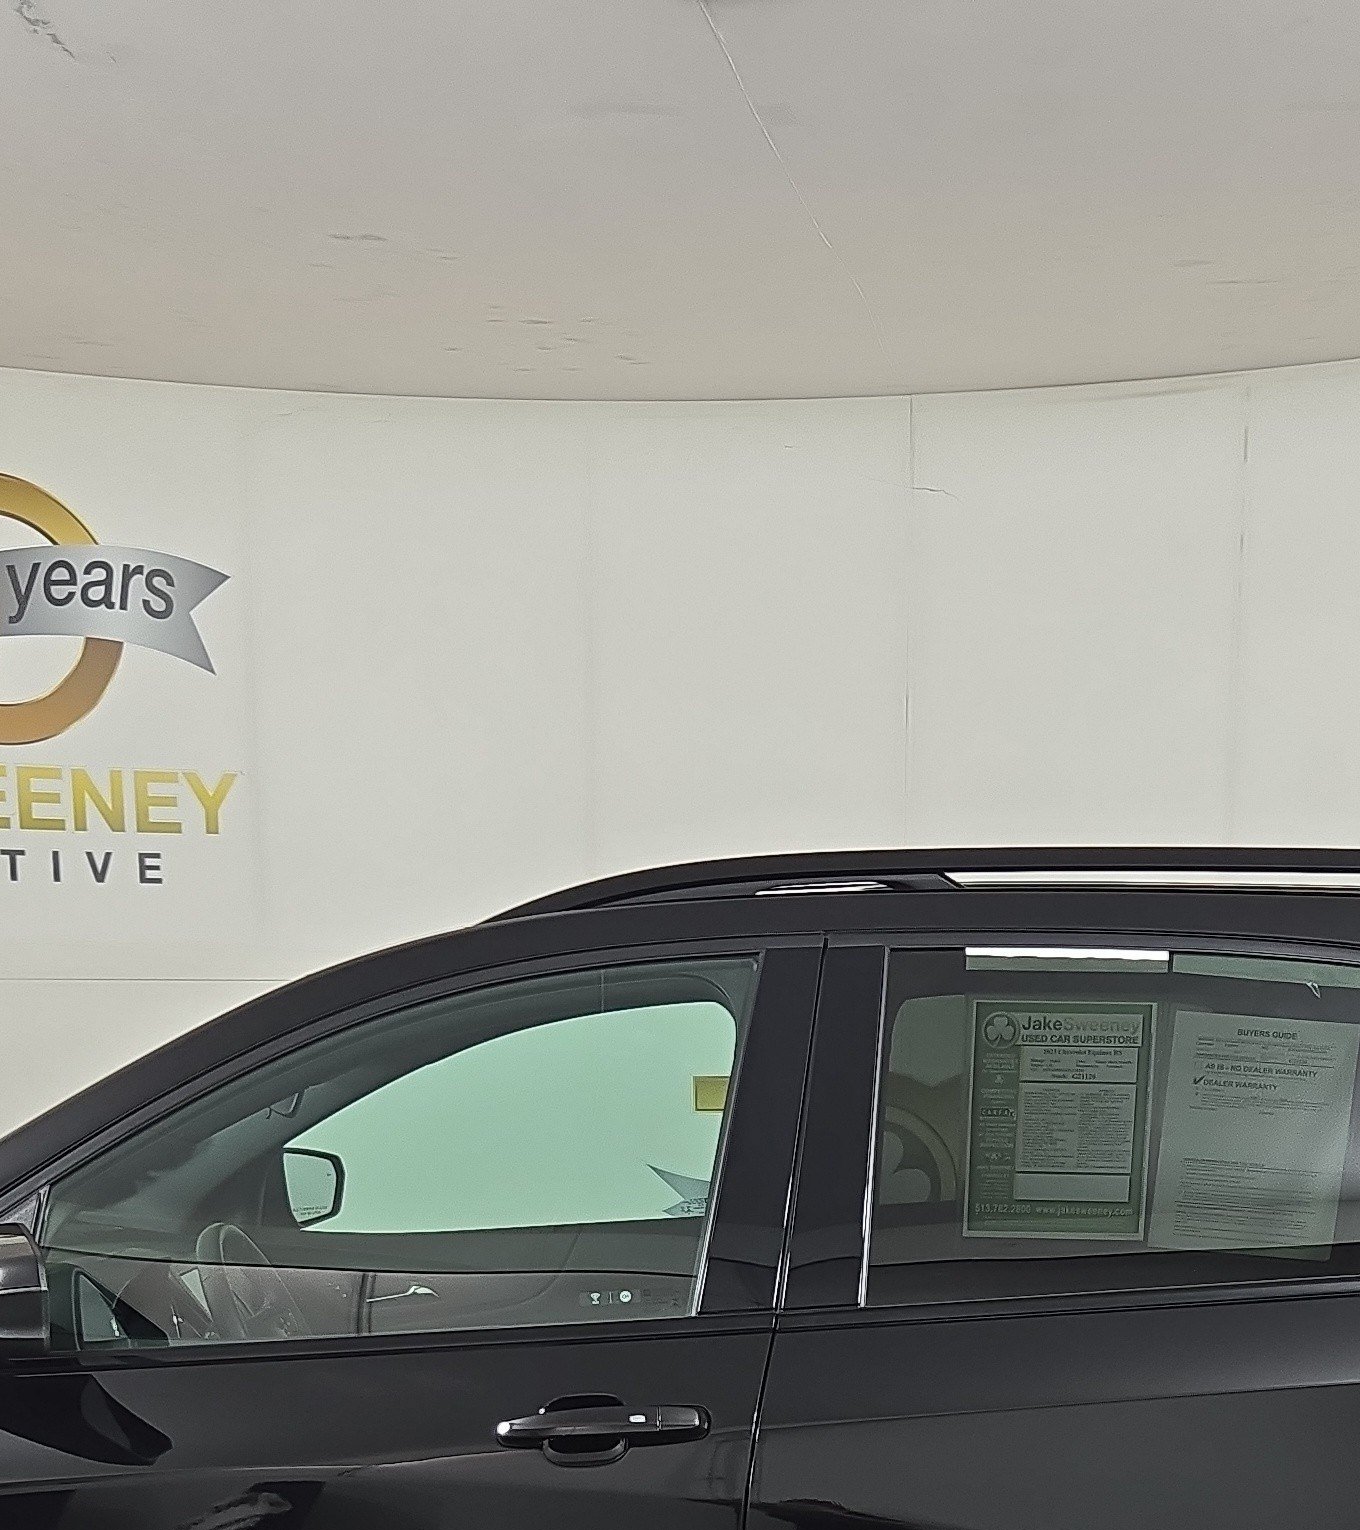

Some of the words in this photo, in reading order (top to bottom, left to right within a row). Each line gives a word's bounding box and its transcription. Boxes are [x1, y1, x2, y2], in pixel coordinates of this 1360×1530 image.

[7, 558, 176, 625] years
[1021, 1035, 1048, 1043] USED
[1050, 1035, 1070, 1043] CAR
[1072, 1035, 1138, 1044] SUPERSTORE
